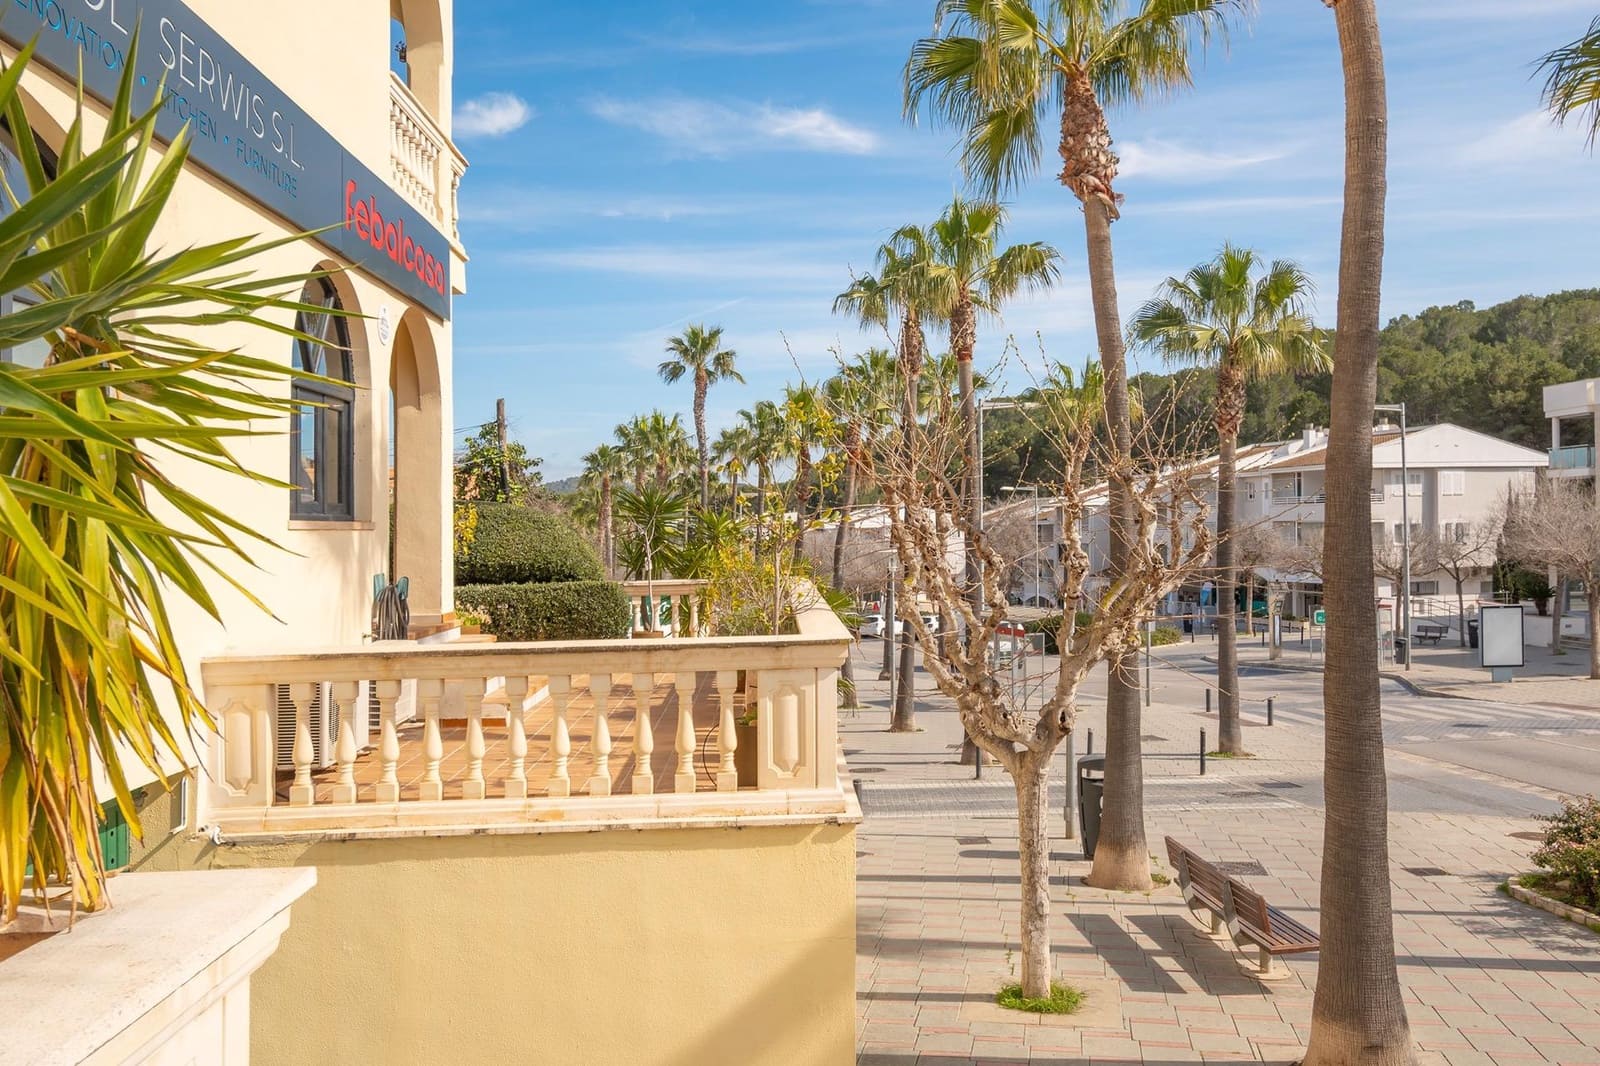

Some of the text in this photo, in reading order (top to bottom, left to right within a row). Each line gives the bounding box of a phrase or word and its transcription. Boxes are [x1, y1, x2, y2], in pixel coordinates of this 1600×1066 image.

[159, 17, 265, 139] SERWIS
[271, 110, 305, 171] S.L.
[236, 137, 298, 199] FURNITURE
[345, 179, 445, 297] febalcasa
